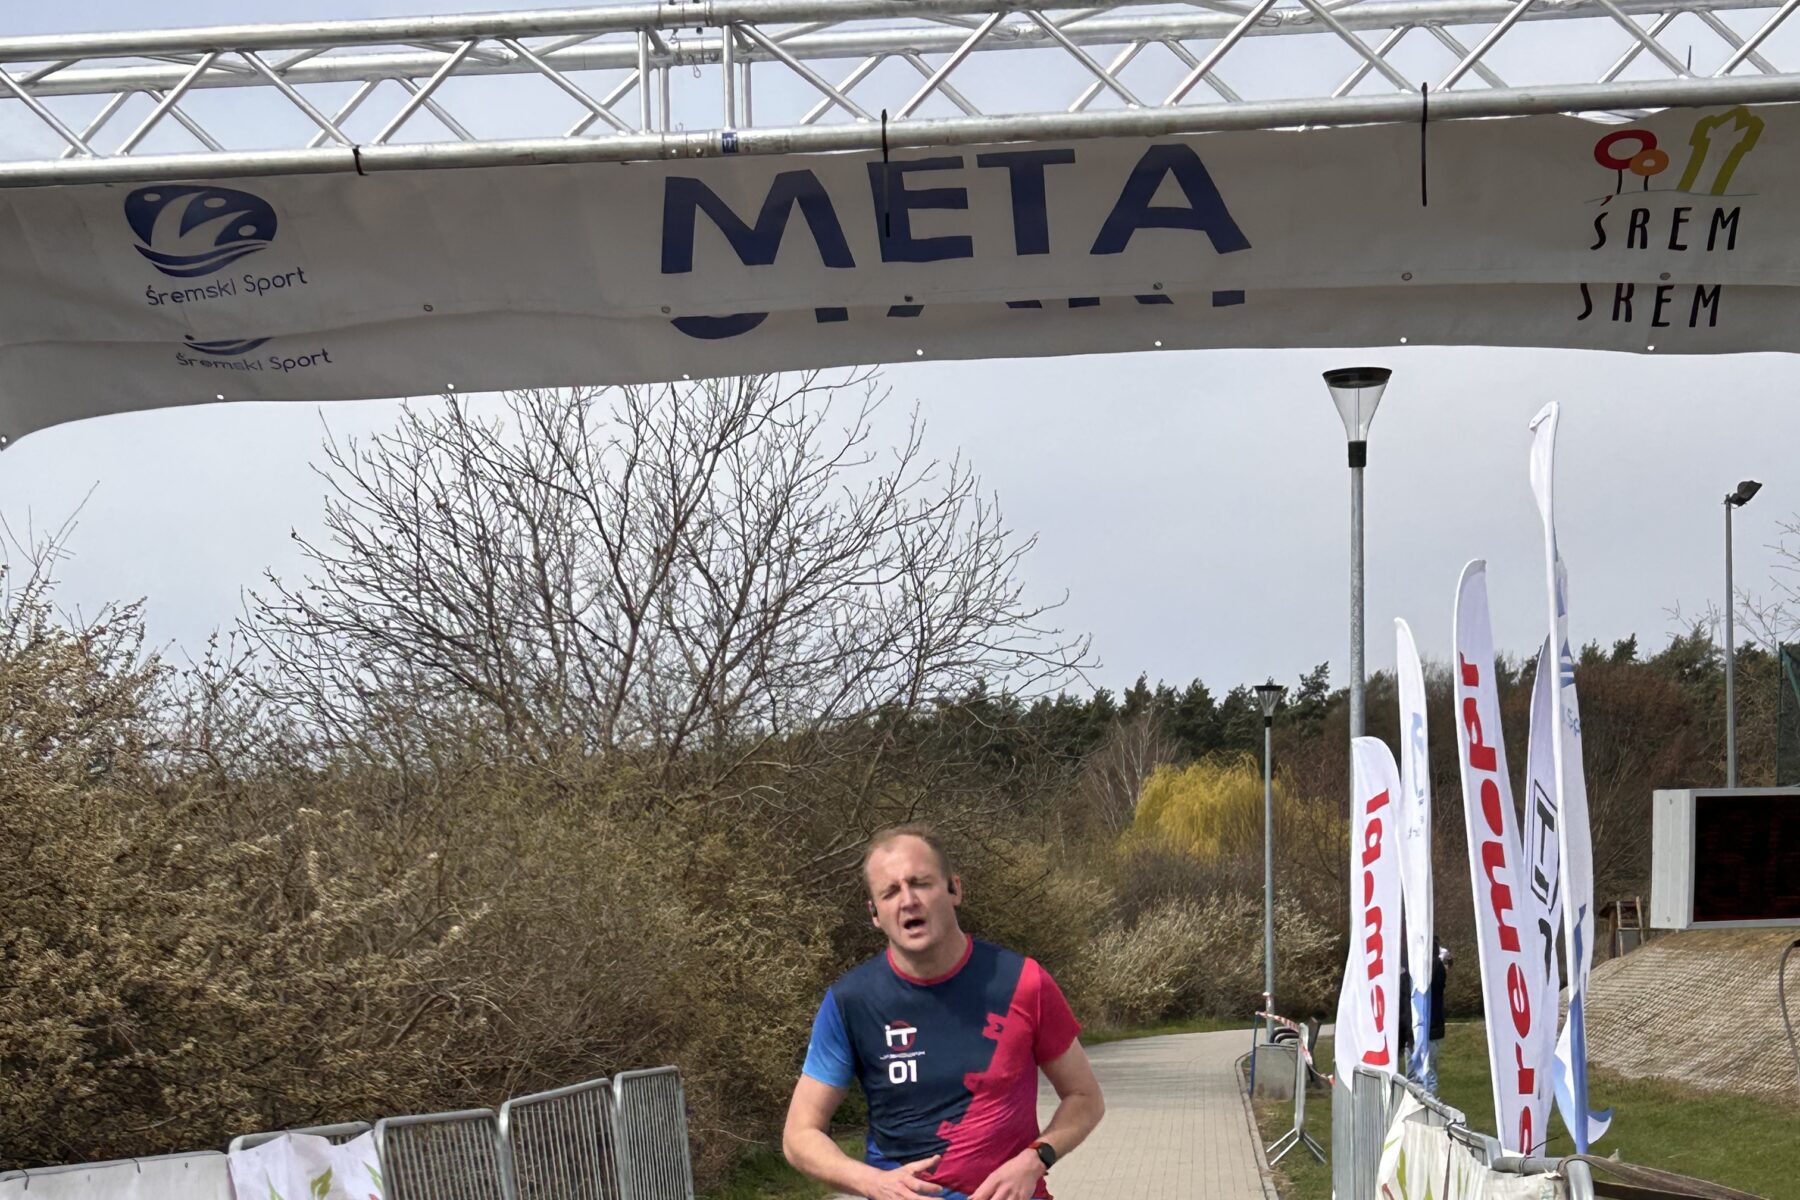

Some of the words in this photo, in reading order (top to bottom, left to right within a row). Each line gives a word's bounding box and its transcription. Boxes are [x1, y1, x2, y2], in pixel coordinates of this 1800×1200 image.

[661, 143, 1253, 275] META
[1590, 194, 1742, 252] ŚREM
[145, 278, 238, 307] Śremski
[243, 266, 308, 297] Sport
[269, 348, 333, 373] Sport
[888, 1059, 918, 1085] 01
